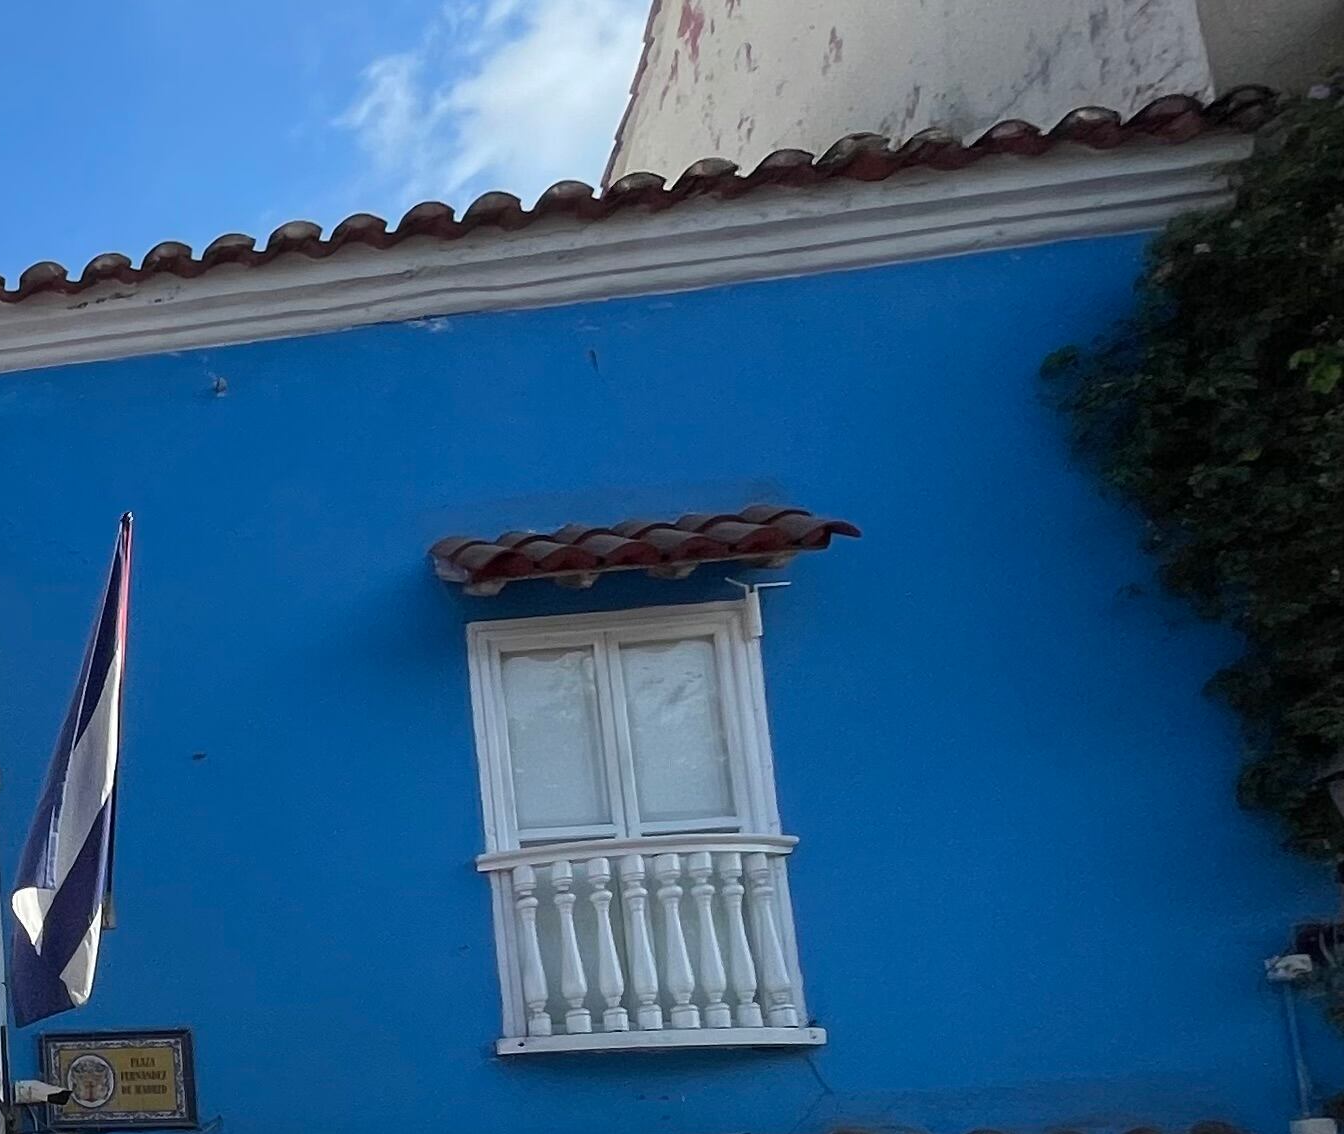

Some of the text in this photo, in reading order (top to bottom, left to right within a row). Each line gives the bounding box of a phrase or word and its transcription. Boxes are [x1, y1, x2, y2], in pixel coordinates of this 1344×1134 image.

[130, 1057, 156, 1067] PLAZA
[121, 1084, 168, 1095] DE MADRID
